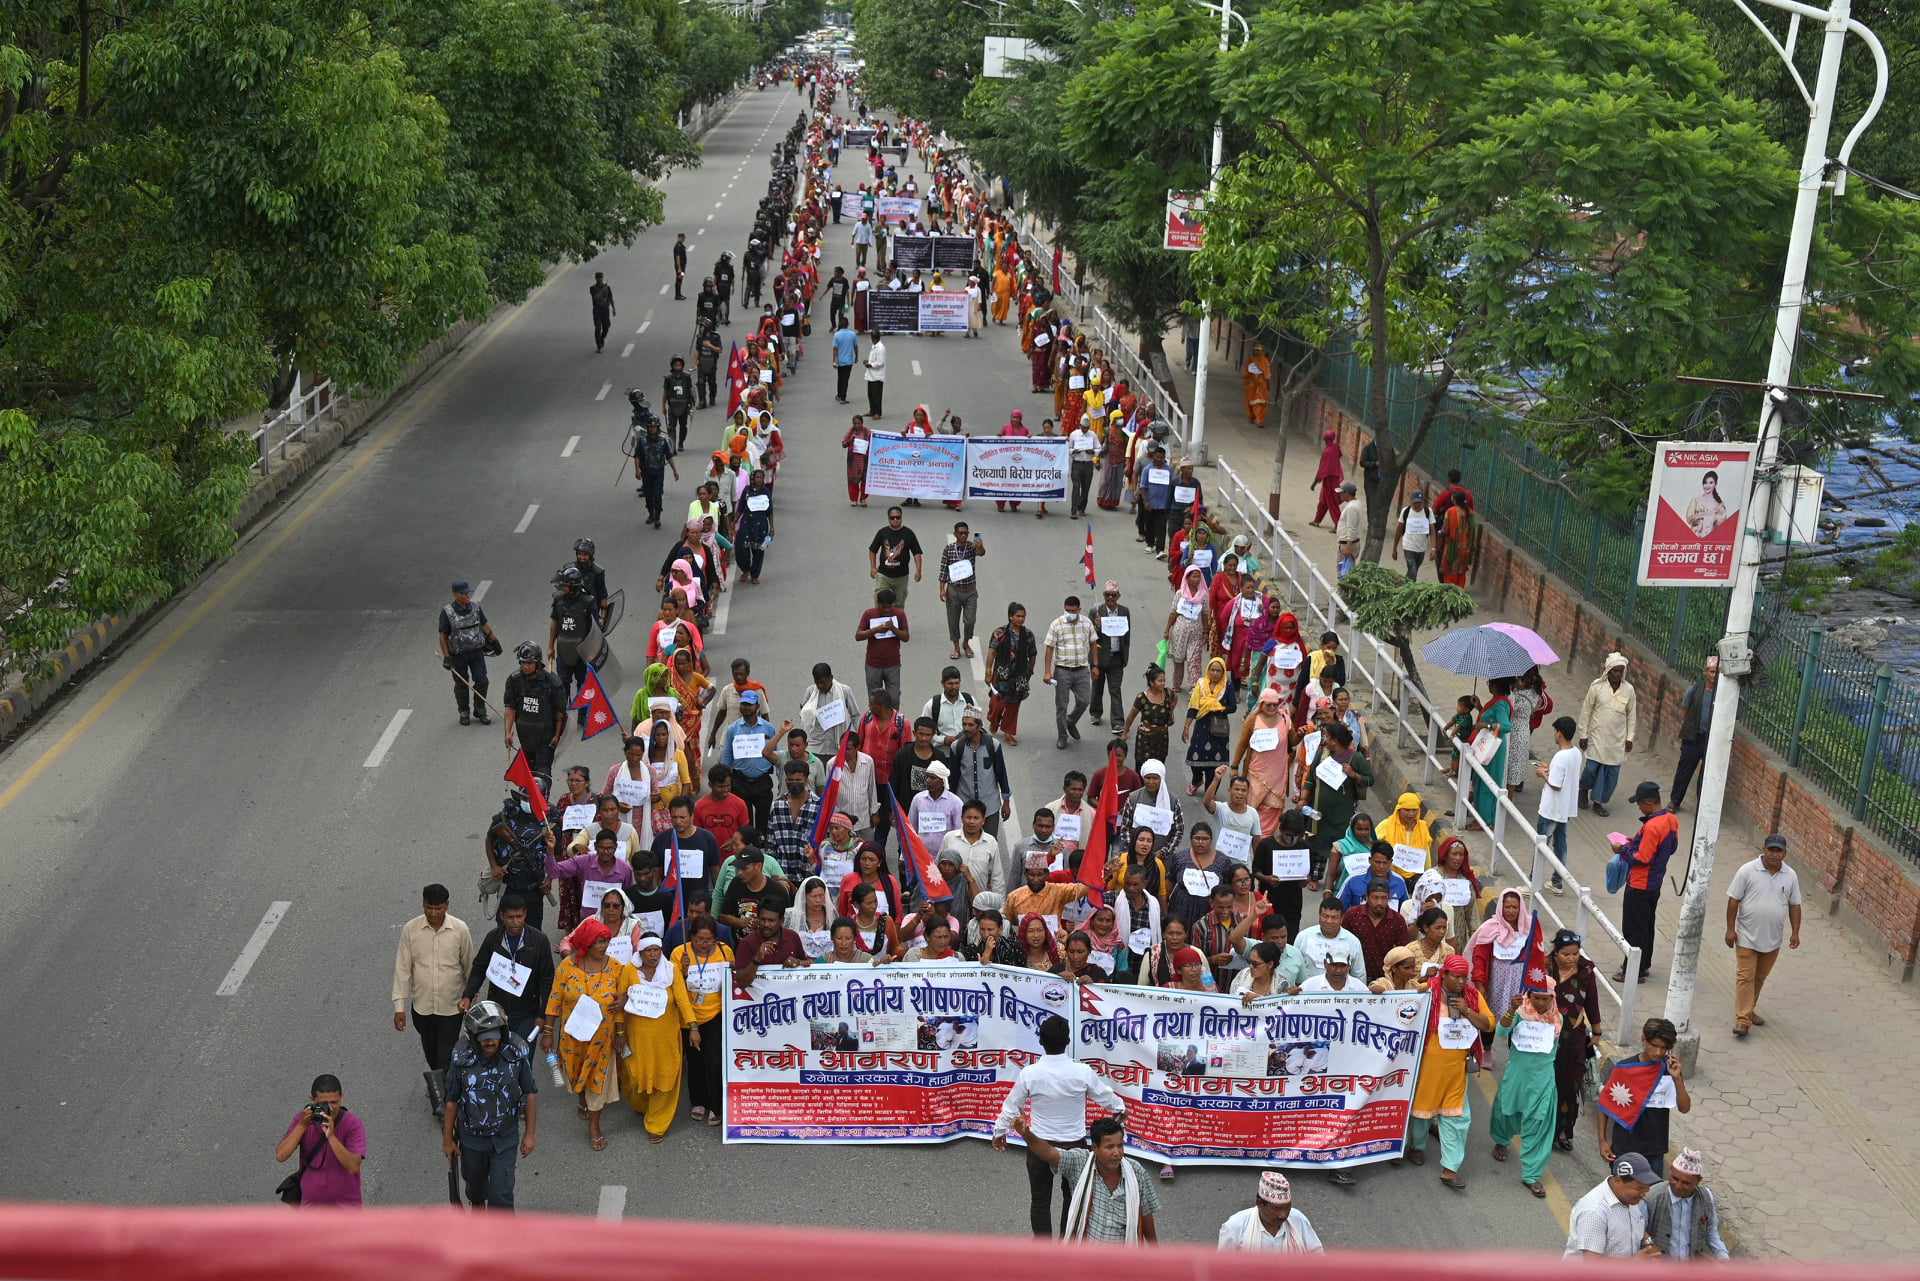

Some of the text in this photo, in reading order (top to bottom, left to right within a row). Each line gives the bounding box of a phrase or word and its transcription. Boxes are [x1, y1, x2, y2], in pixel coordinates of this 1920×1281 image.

[1683, 453, 1719, 462] NIC ASIA
[972, 465, 1007, 479] देशव्यापी
[1010, 466, 1031, 479] विरोध
[1657, 552, 1699, 564] सम्भव
[523, 696, 539, 705] NEPAL
[522, 703, 540, 713] POLICE
[733, 992, 797, 1035] लघुवित्त
[802, 990, 841, 1019] तथा
[846, 979, 904, 1015] वित्तीय
[910, 978, 994, 1018] शोषणको
[1080, 1006, 1148, 1049] लघुवित्त
[1152, 1012, 1194, 1039] तथा
[1199, 1005, 1259, 1040] वित्तीय
[1264, 1006, 1347, 1042] शोषणको
[733, 1044, 808, 1071] हाम्रो
[819, 1049, 940, 1072] आमरण
[854, 1073, 898, 1084] सरकार
[1163, 1072, 1289, 1097] आमरण
[1299, 1069, 1410, 1095] अनशन
[1198, 1099, 1242, 1110] सरकार
